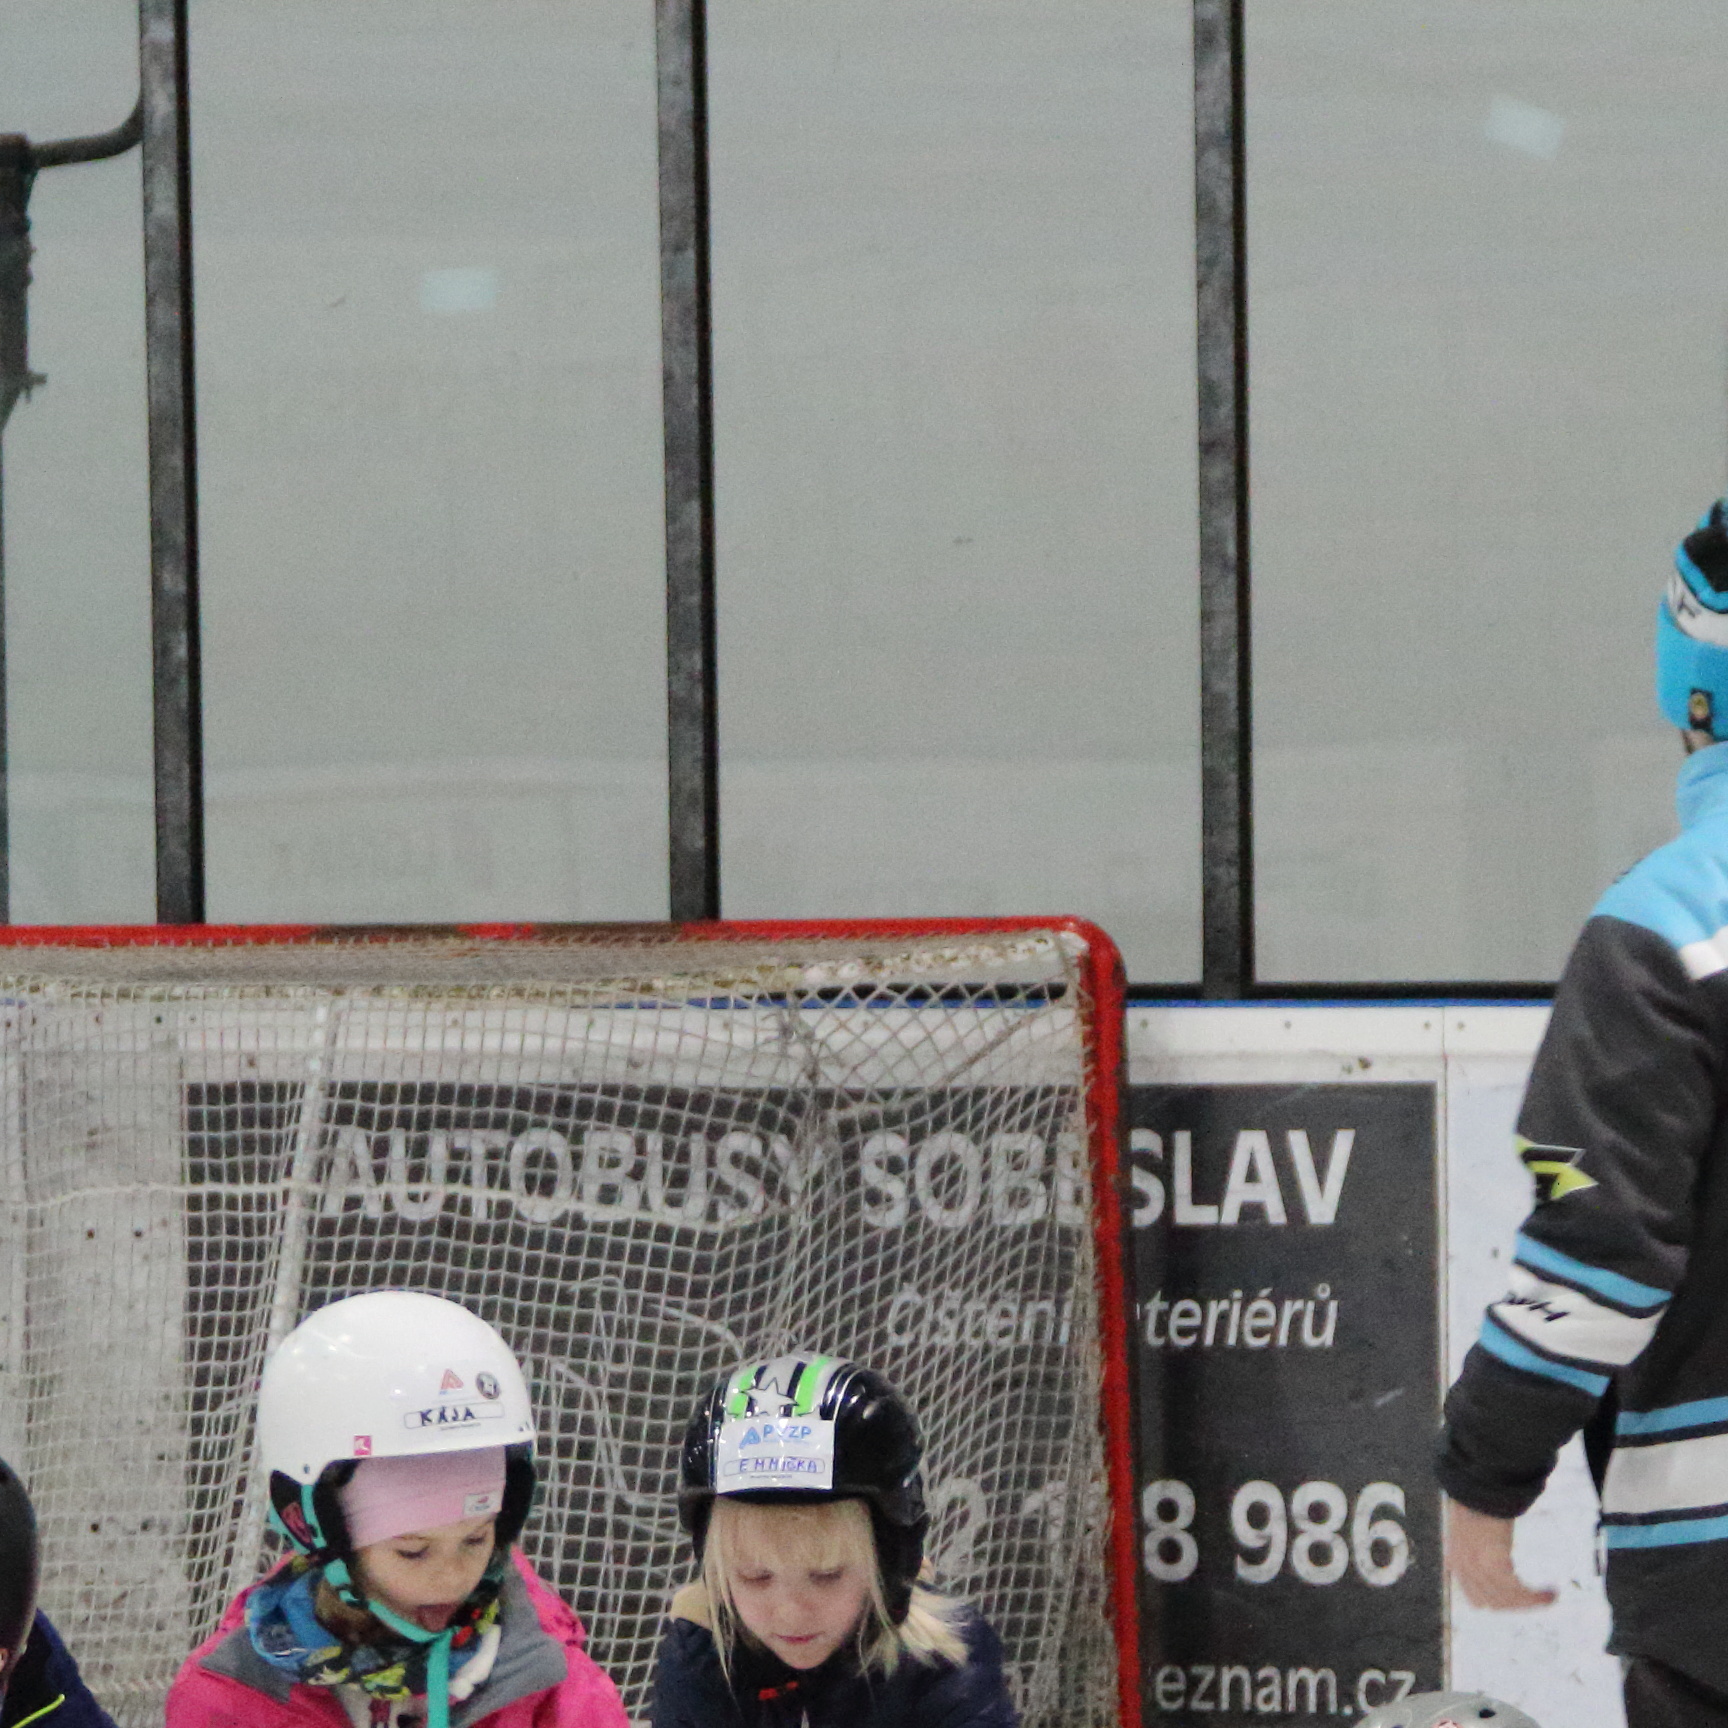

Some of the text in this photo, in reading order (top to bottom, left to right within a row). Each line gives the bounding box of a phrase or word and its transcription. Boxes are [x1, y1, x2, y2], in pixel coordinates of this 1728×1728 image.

[1136, 1283, 1339, 1348] teriérů
[1230, 1480, 1410, 1588] 986
[1155, 1662, 1416, 1714] eznam.cz
